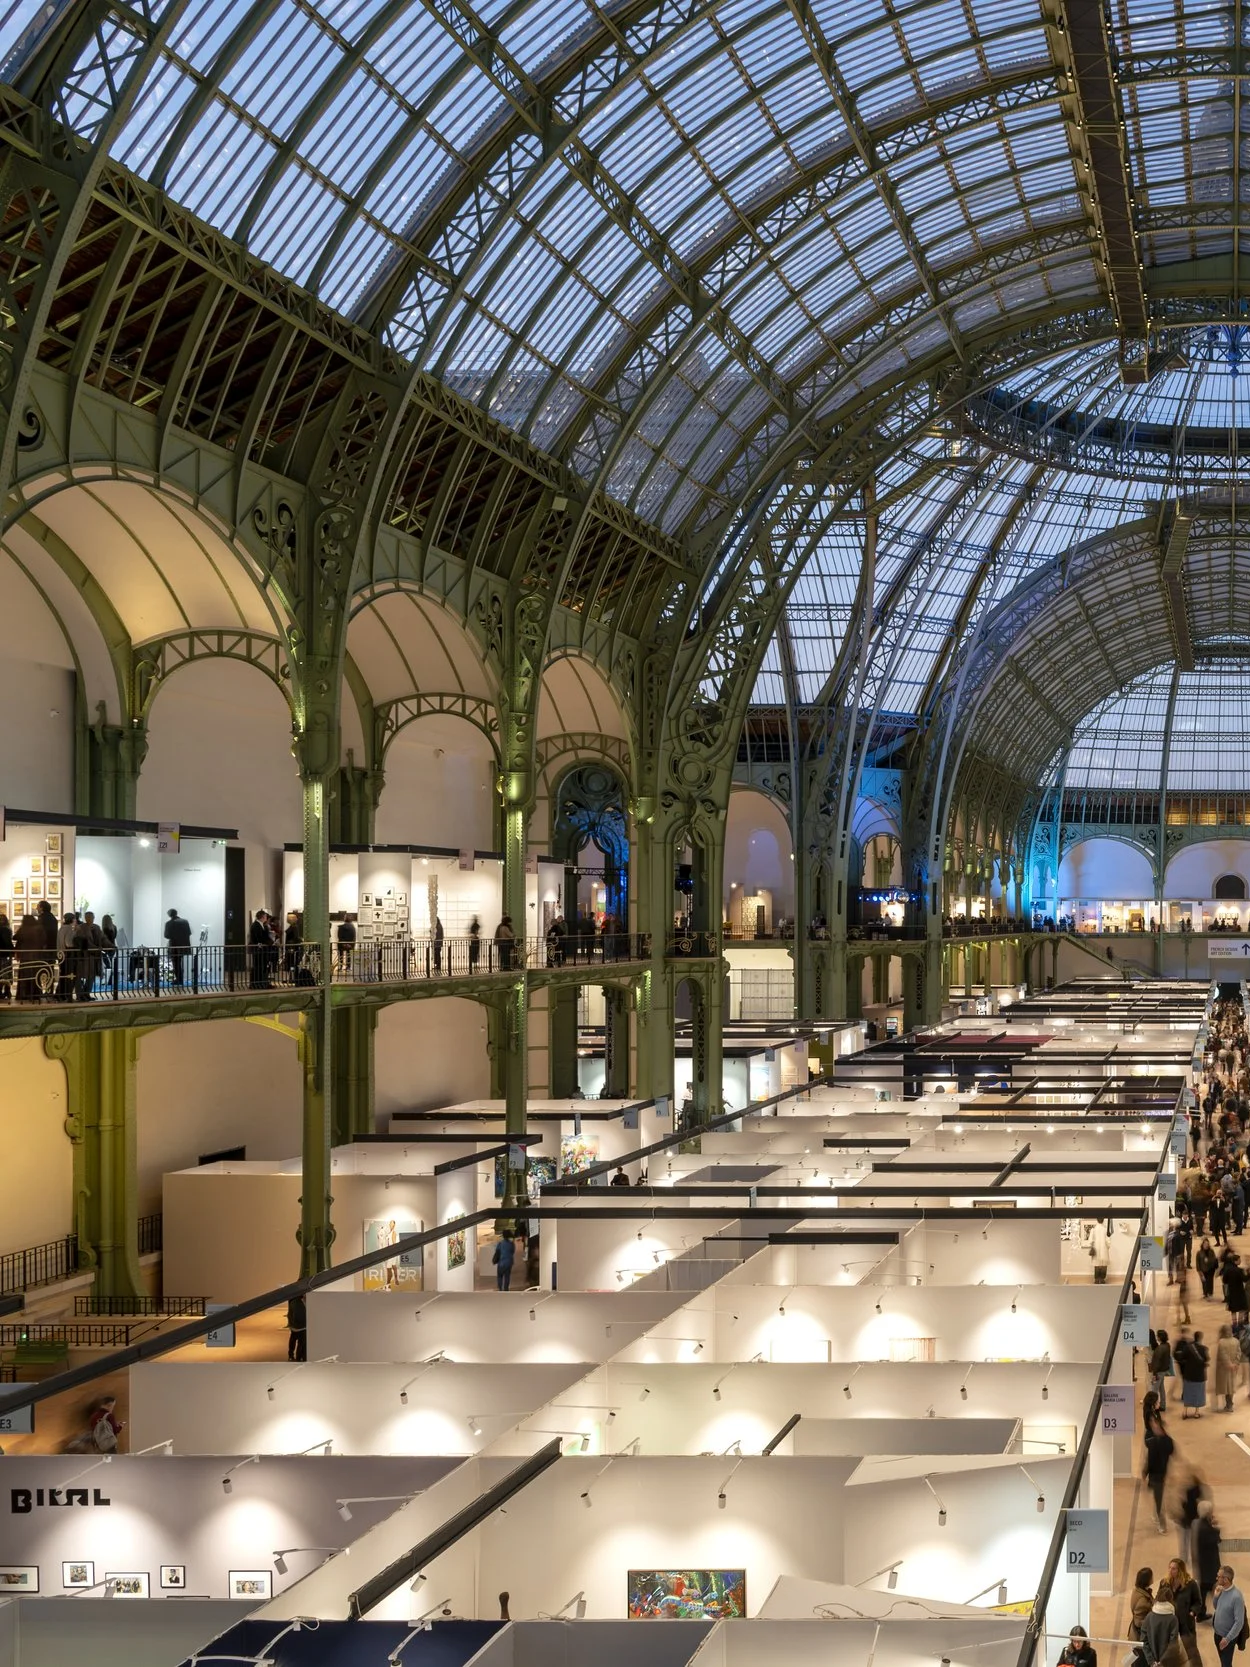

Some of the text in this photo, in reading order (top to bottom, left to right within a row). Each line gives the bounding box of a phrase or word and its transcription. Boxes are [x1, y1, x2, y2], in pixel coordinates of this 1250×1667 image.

[207, 1331, 218, 1340] E4
[1123, 1331, 1134, 1339] D4
[0, 1419, 12, 1429] E3
[1104, 1418, 1117, 1428] D3
[1069, 1551, 1086, 1565] D2
